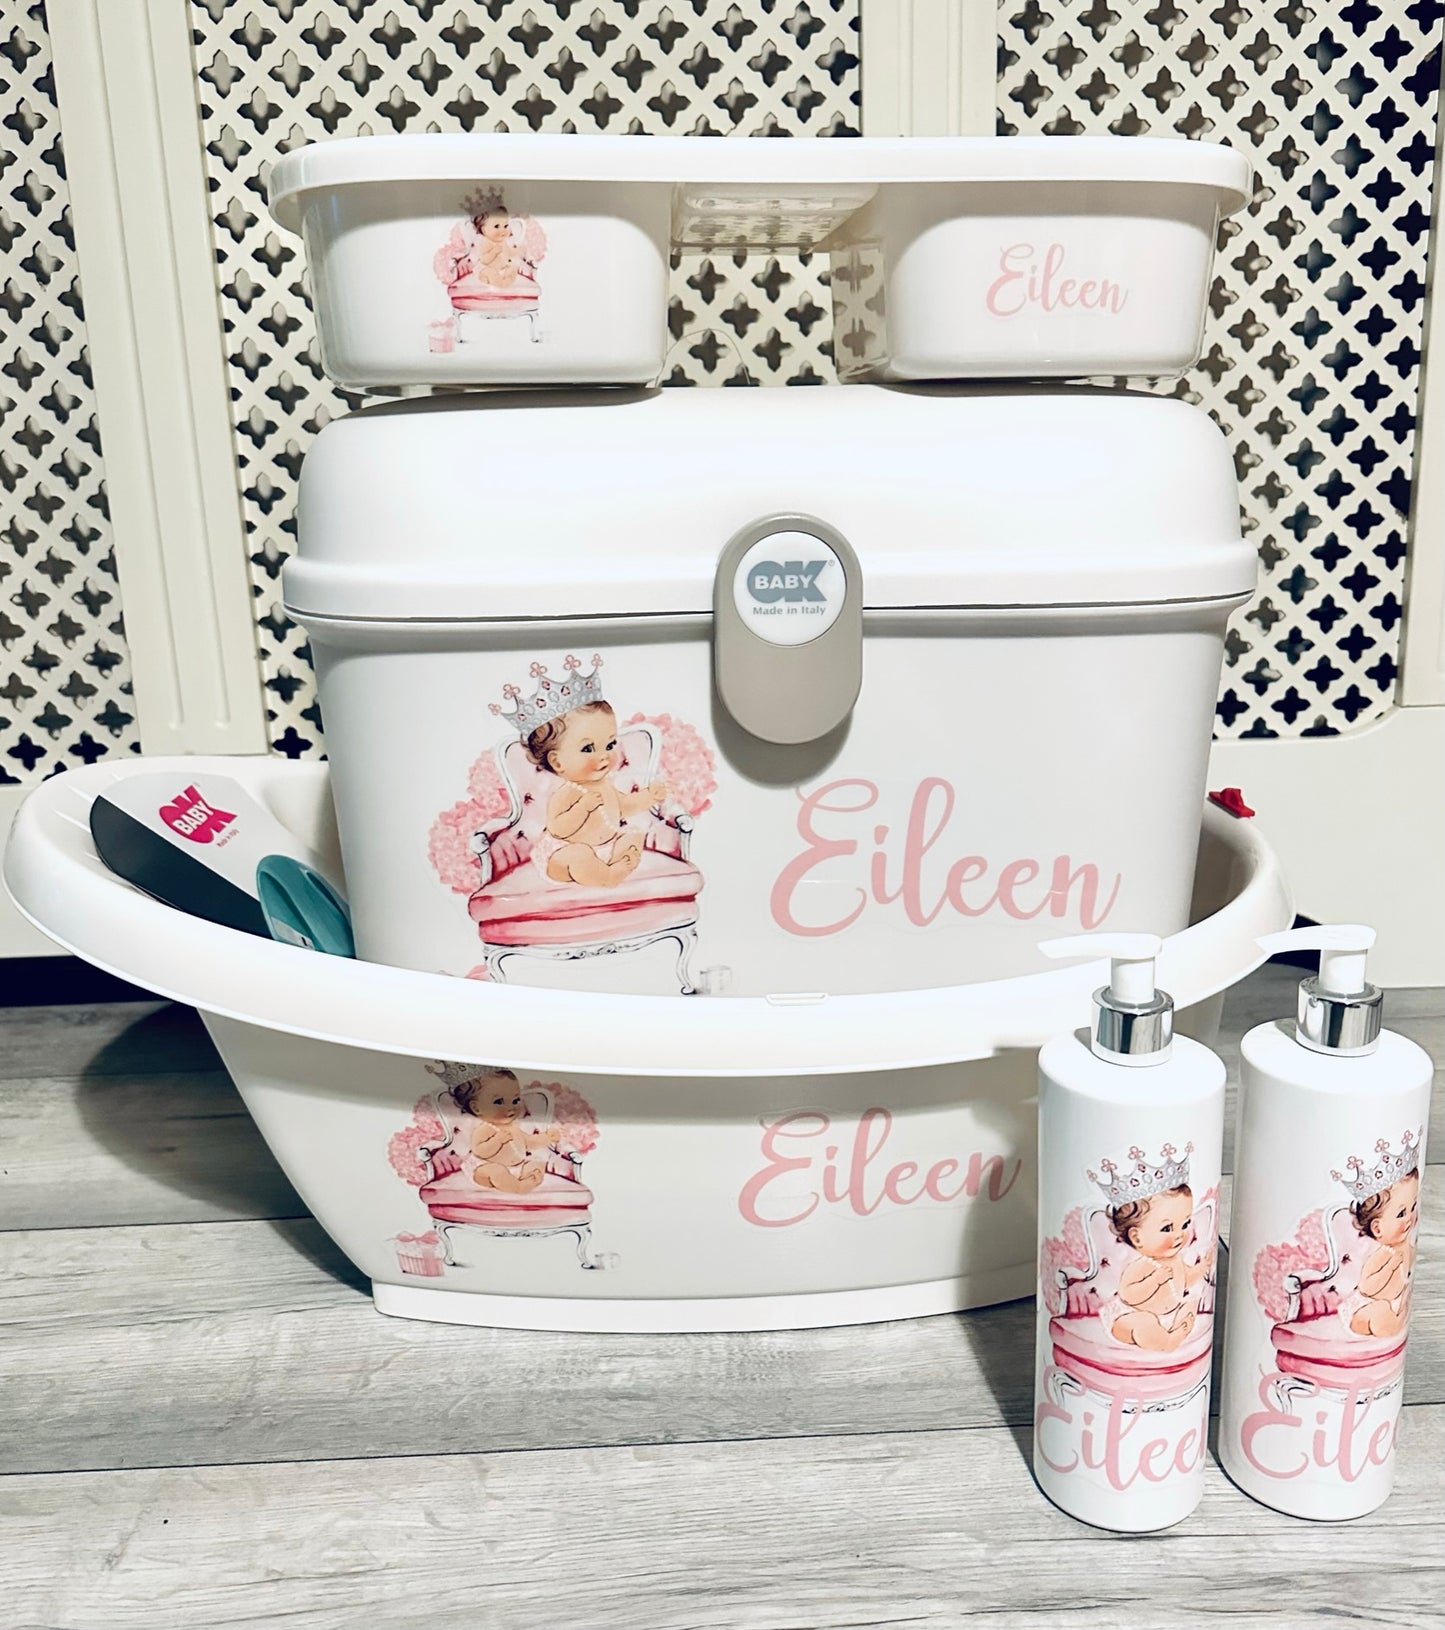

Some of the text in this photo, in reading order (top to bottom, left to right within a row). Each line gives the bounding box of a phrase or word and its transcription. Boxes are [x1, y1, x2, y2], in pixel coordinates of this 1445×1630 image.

[986, 243, 1128, 316] Eileen
[747, 560, 828, 604] OK
[755, 574, 813, 590] BABY
[753, 605, 826, 616] Made in Italy
[172, 800, 214, 835] BABY
[770, 776, 1122, 937] Eileen
[738, 1107, 1022, 1228] Eileen
